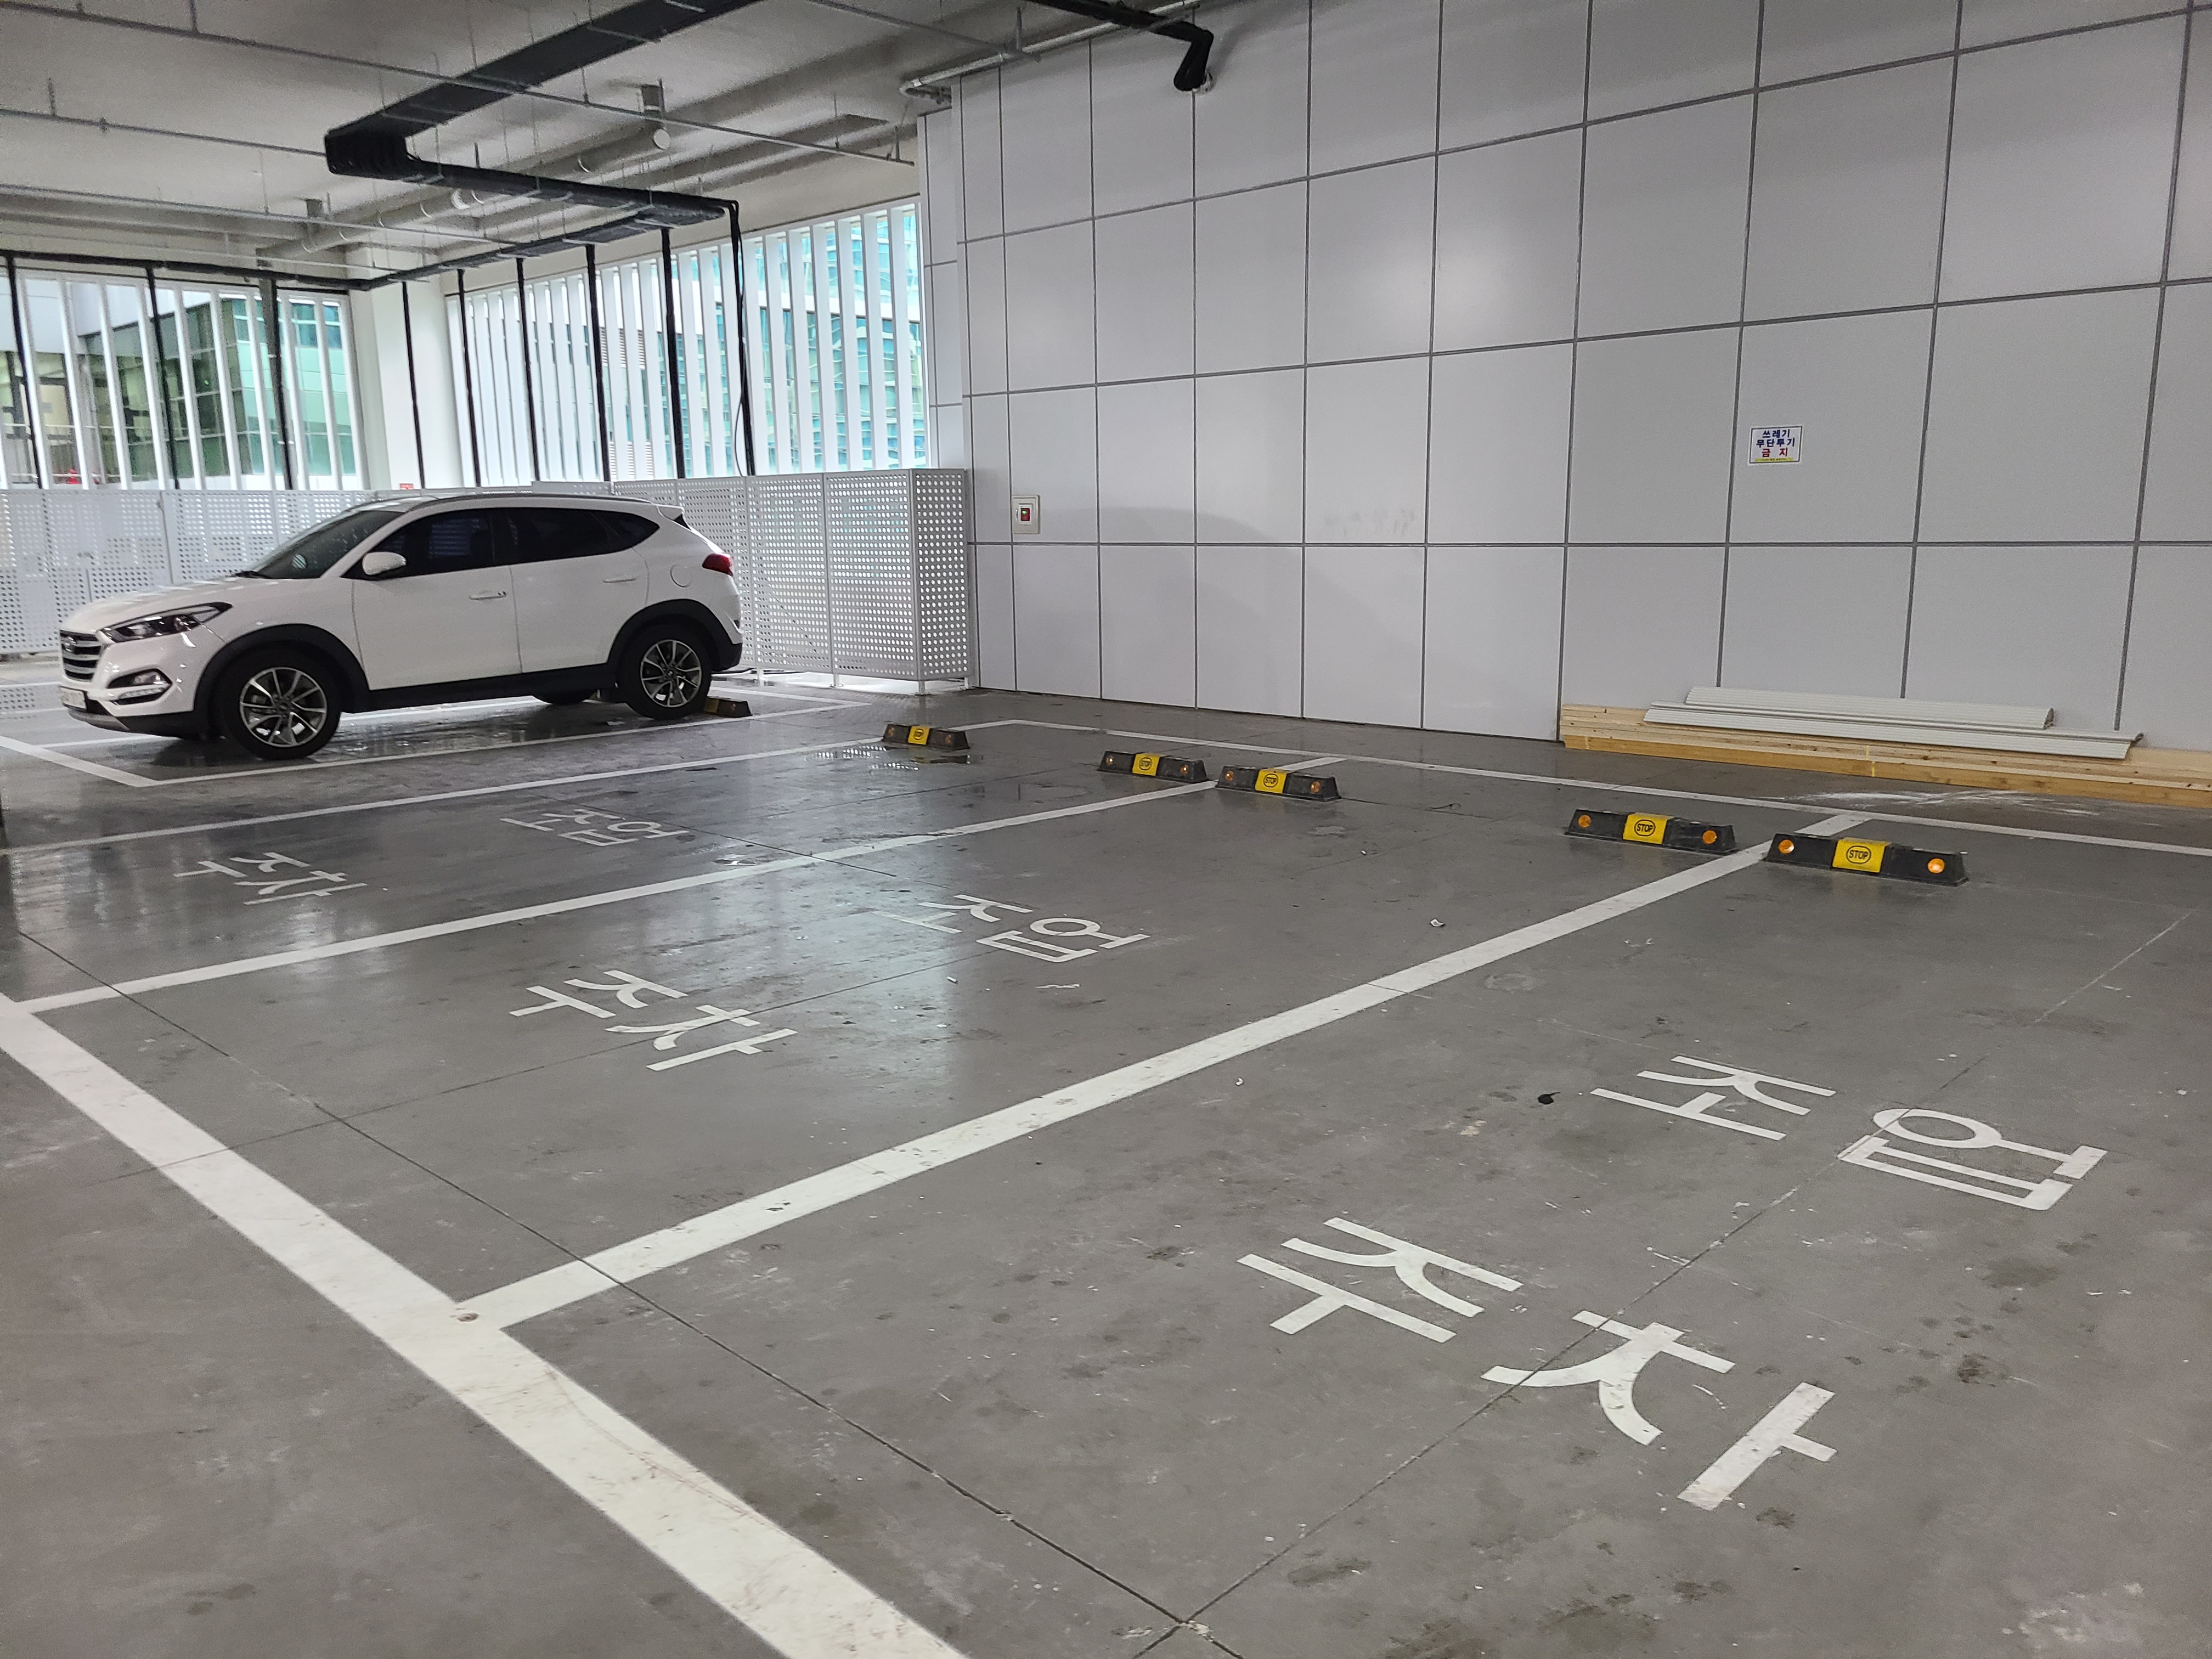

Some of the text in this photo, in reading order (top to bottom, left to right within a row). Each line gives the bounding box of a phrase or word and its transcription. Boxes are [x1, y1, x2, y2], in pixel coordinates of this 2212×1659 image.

[1756, 437, 1795, 448] 무단투기
[1762, 429, 1790, 438] 쓰레기
[500, 808, 690, 847] 조업
[1637, 823, 1652, 833] STOP
[1849, 849, 1868, 860] STOP
[173, 852, 367, 906] 주차
[873, 894, 1150, 963] 조업
[510, 970, 798, 1071] 주차
[1590, 1056, 2108, 1211] 조업
[1237, 1217, 1836, 1510] 주차
